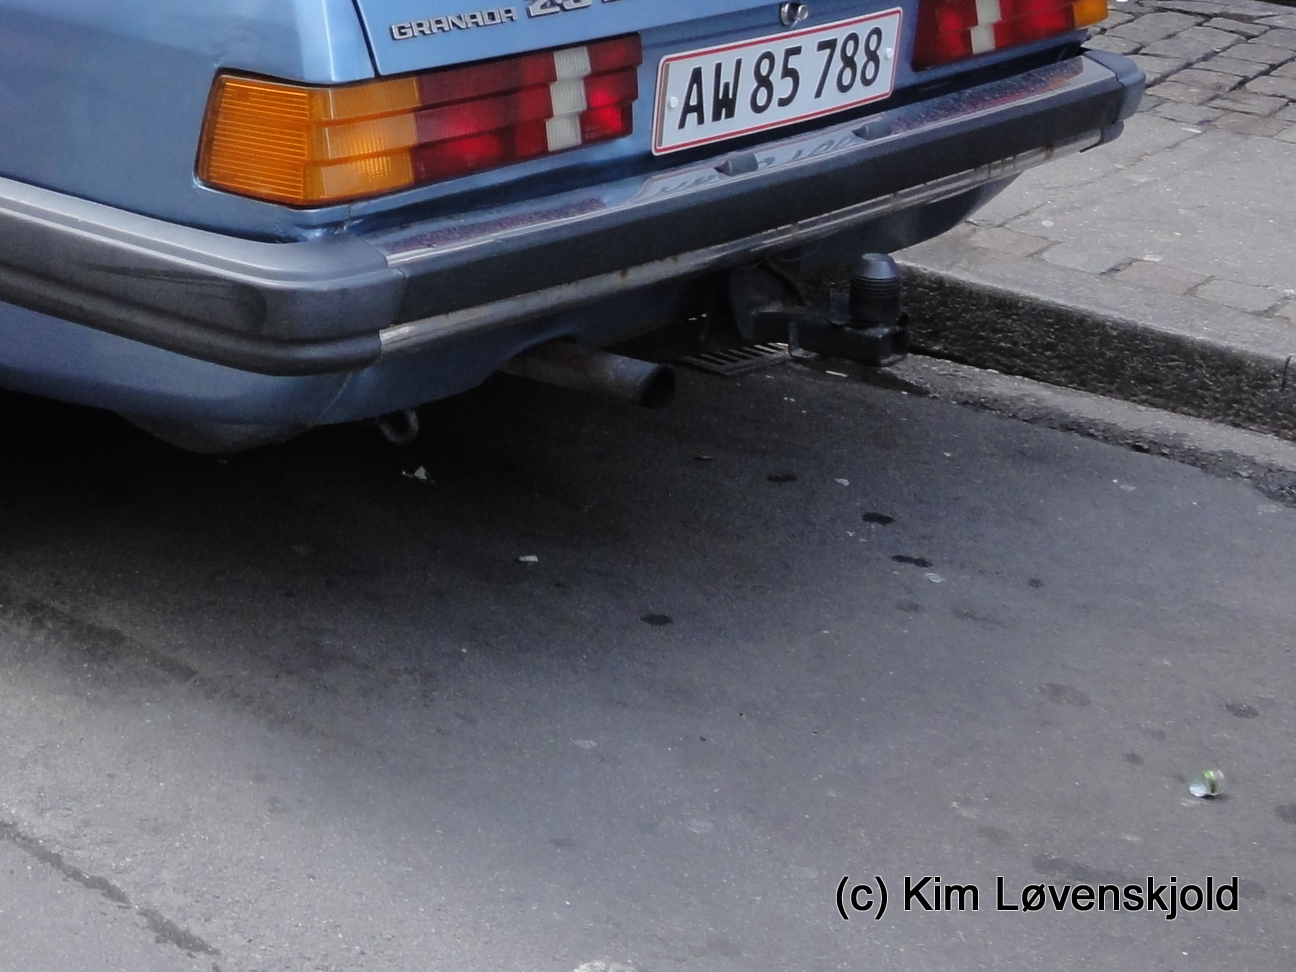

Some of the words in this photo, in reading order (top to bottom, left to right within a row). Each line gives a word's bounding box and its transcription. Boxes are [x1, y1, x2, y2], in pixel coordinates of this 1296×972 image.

[390, 6, 518, 41] GRANADA
[677, 58, 742, 130] AW
[750, 45, 802, 114] 85
[814, 26, 883, 100] 788
